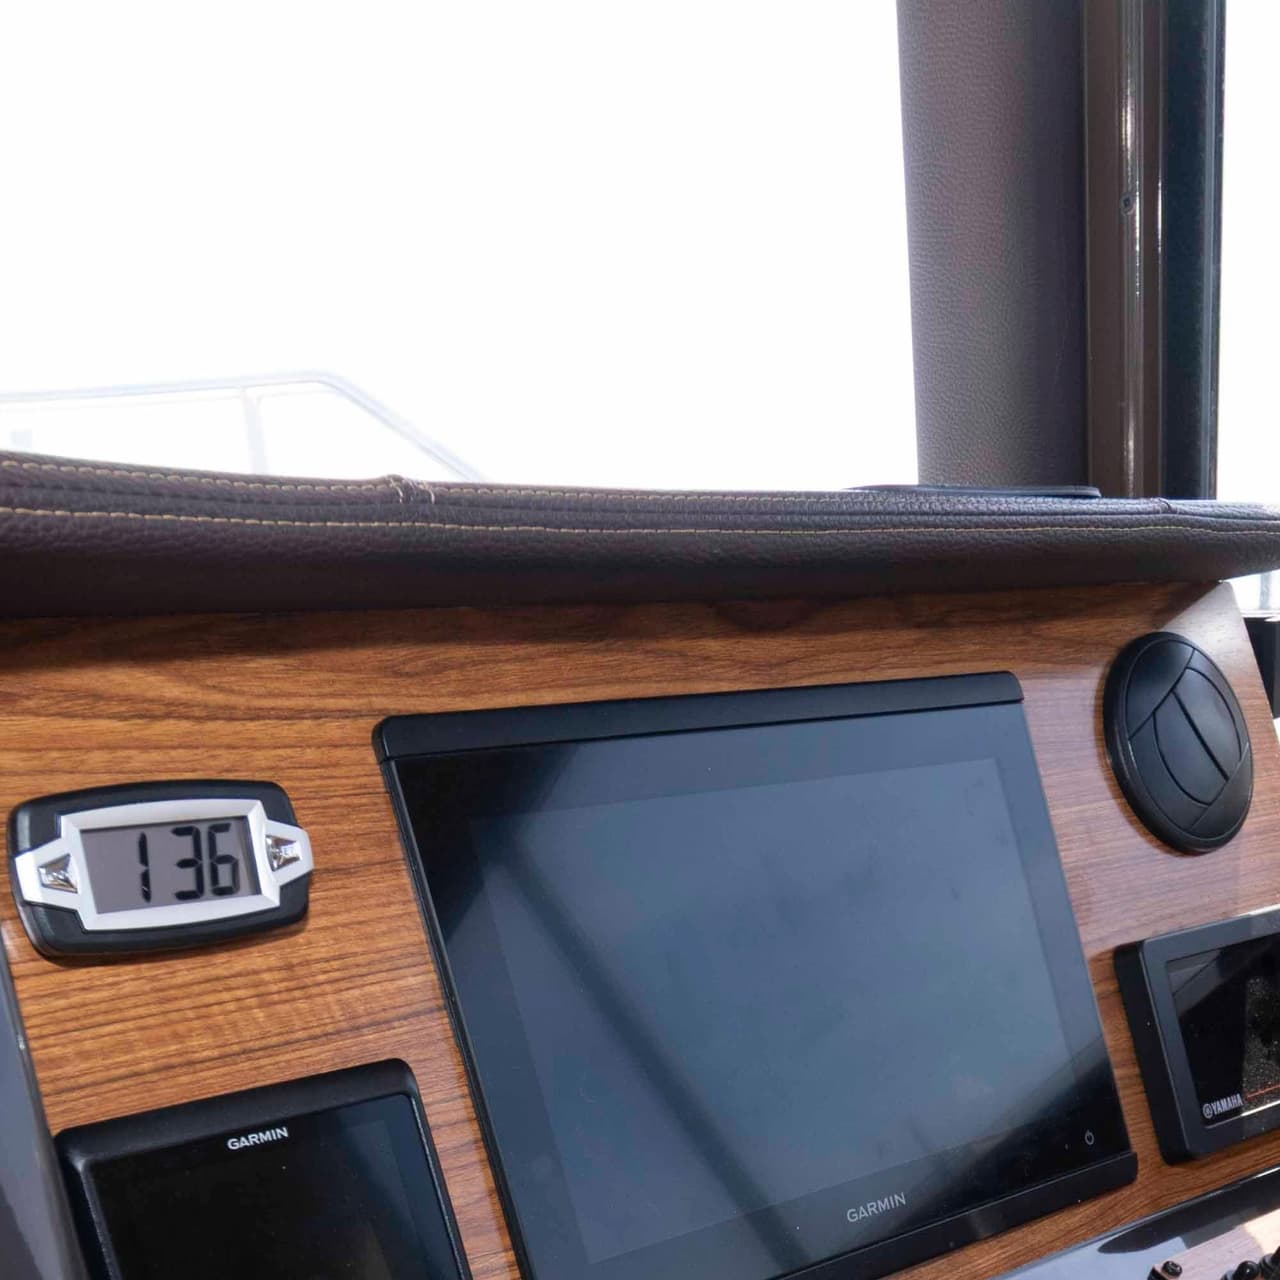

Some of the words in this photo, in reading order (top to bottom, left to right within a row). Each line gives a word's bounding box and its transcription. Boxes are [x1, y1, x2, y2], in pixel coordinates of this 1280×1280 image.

[137, 822, 240, 904] 136
[1210, 1093, 1244, 1115] YAMAHA
[227, 1126, 289, 1150] GARMIN
[846, 1192, 907, 1222] GARMIN
